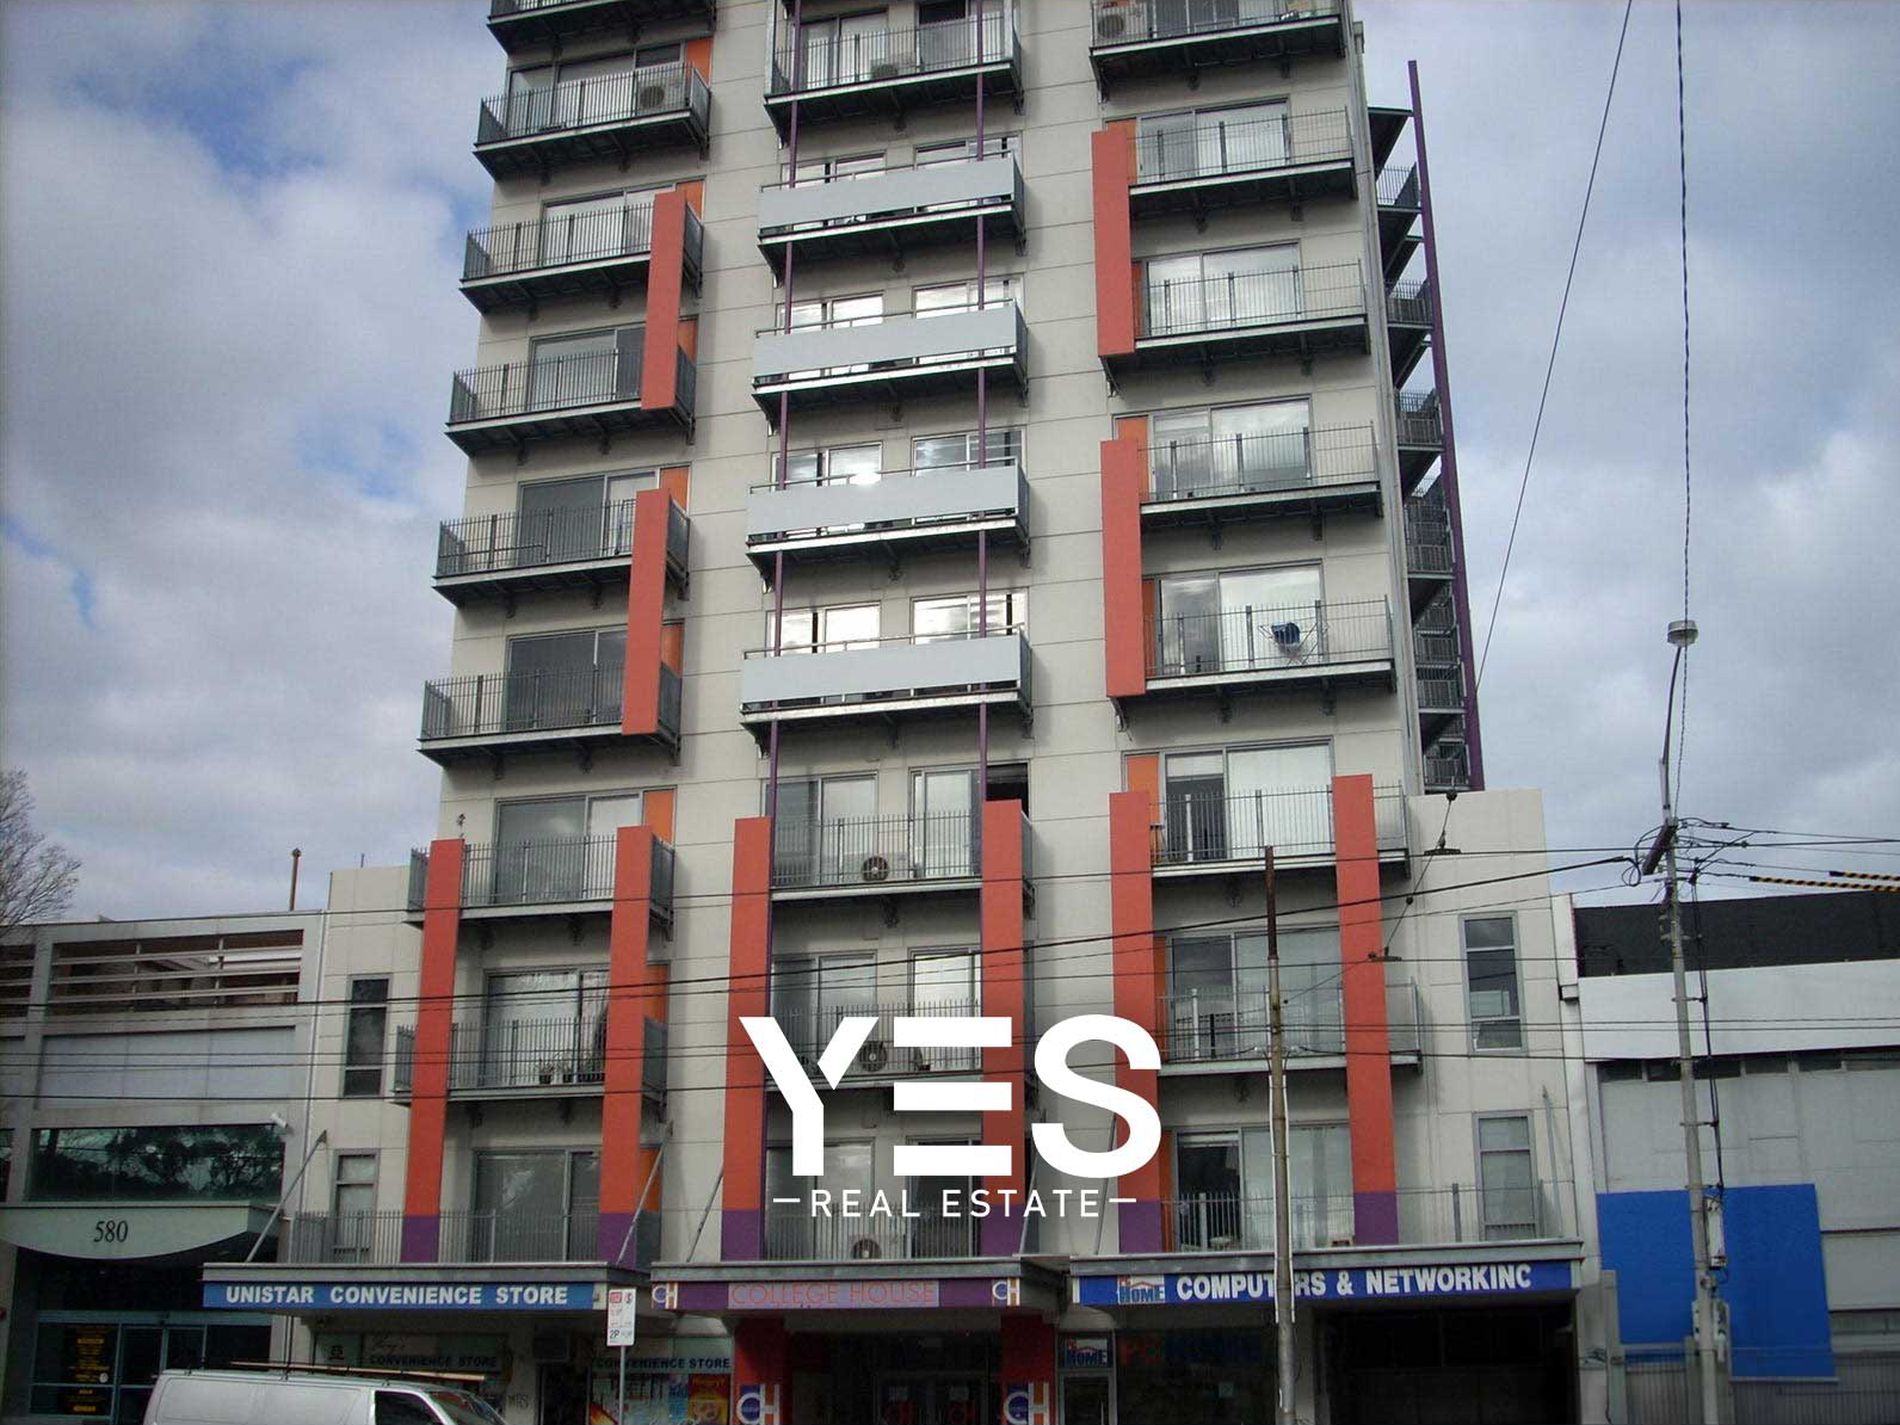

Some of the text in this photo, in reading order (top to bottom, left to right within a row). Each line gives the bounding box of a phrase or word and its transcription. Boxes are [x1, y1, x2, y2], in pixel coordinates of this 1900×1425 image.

[93, 1219, 129, 1244] 580
[226, 1284, 569, 1305] UNISTAR CONVENIENCE STORE
[732, 1279, 936, 1305] COLLEGE HOUSE
[1176, 1271, 1326, 1301] COMPUTRS
[1336, 1270, 1354, 1296] &
[369, 1355, 497, 1369] CONVENIENCE STORE
[689, 1358, 731, 1369] STORE
